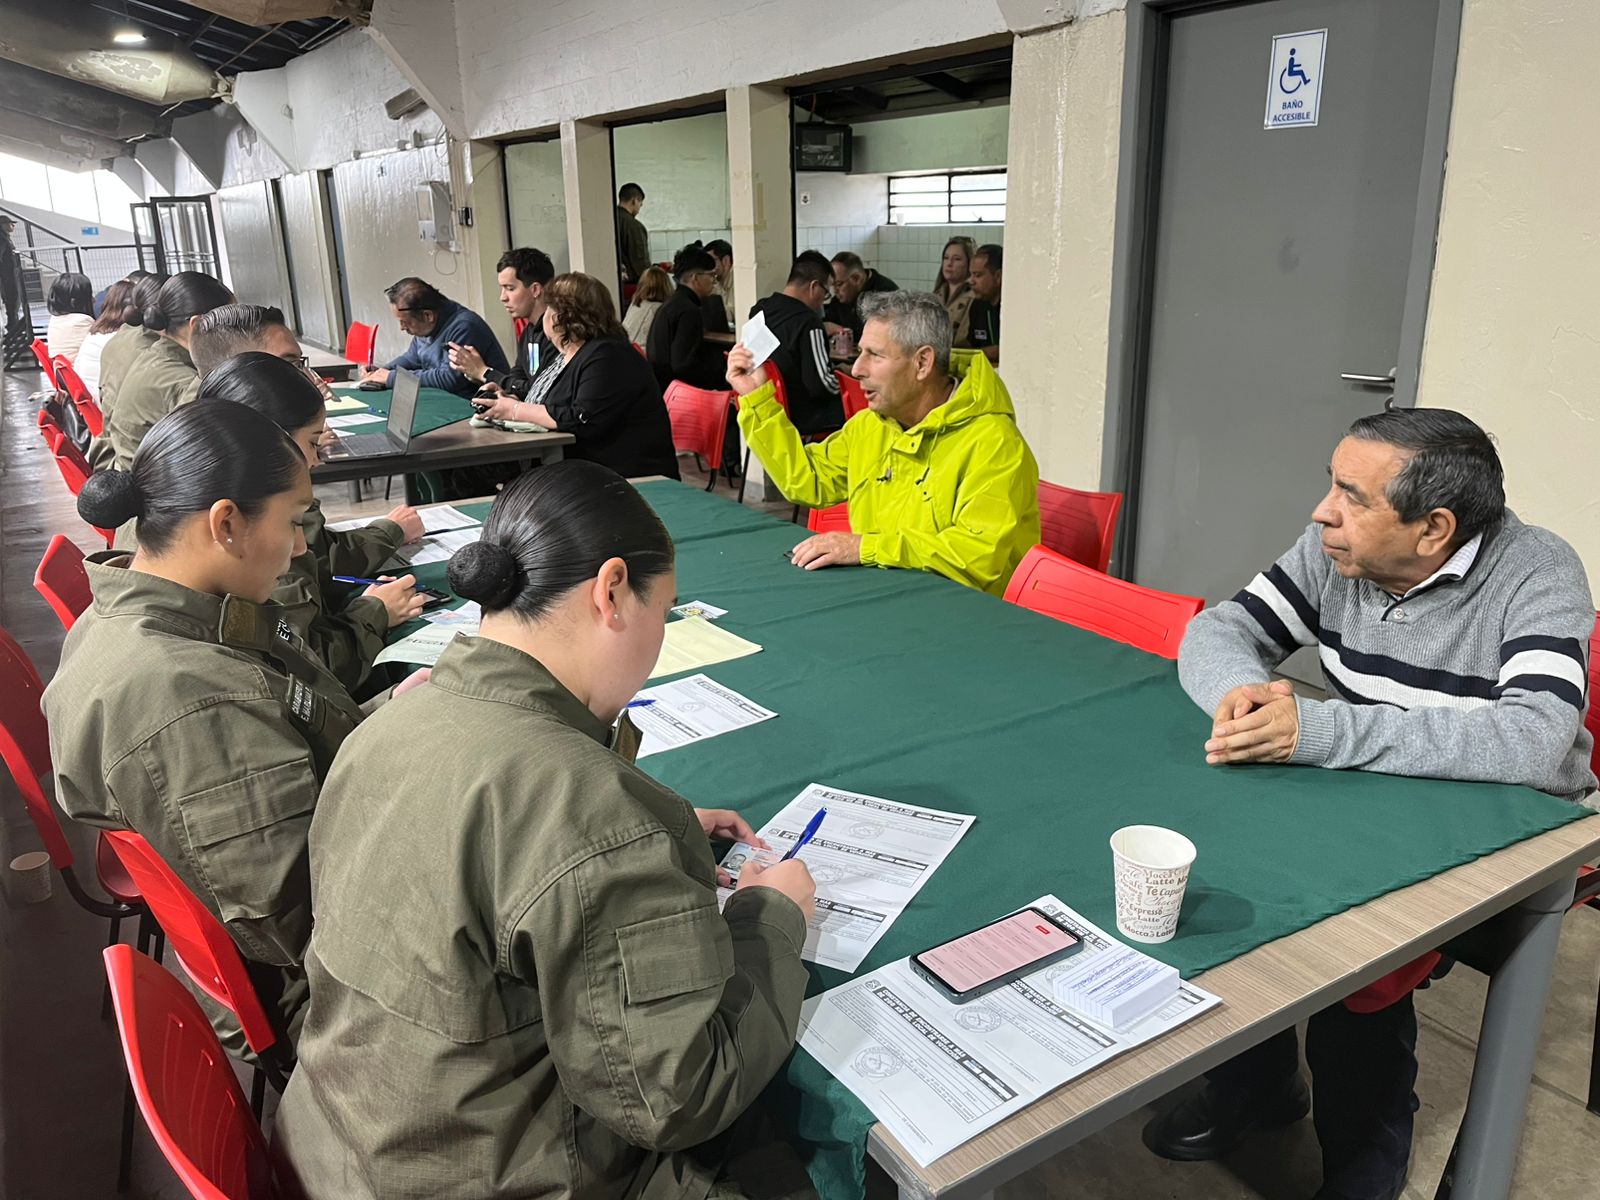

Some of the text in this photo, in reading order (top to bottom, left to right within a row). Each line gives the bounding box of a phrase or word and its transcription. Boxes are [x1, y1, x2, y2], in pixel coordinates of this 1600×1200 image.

[1282, 100, 1303, 110] BAÑO
[1273, 112, 1310, 122] ACCESIBLE
[1146, 877, 1174, 885] Latte
[1146, 886, 1158, 895] Té
[1124, 924, 1148, 936] Mocca
